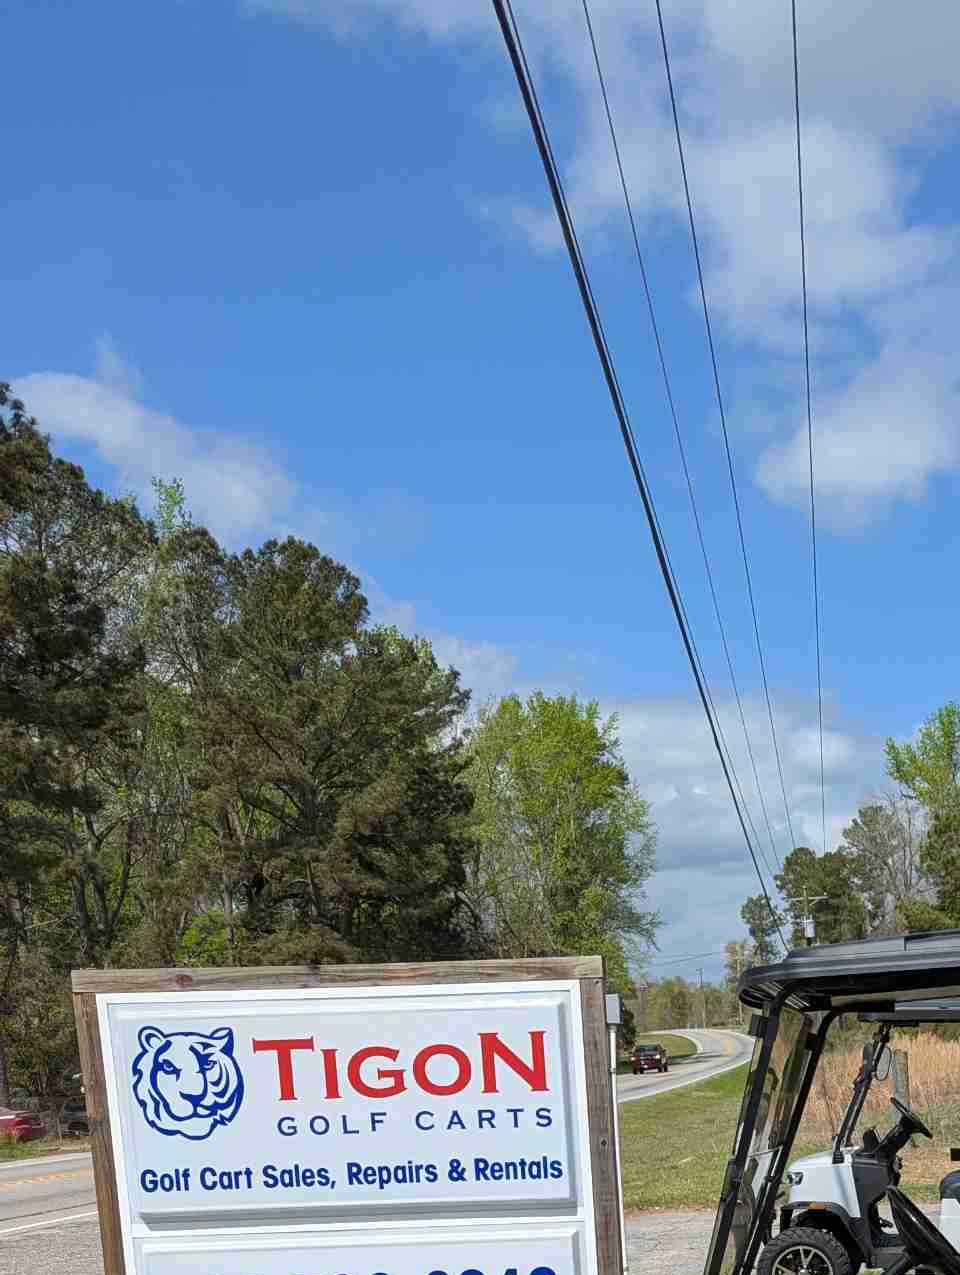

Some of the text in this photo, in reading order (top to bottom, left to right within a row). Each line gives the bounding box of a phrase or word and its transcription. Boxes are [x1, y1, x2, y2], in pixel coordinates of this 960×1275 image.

[252, 1030, 549, 1100] TIGON
[277, 1107, 554, 1136] GOLF CARTS
[140, 1155, 564, 1193] Golf Cart Sales, Repairs & Rentals
